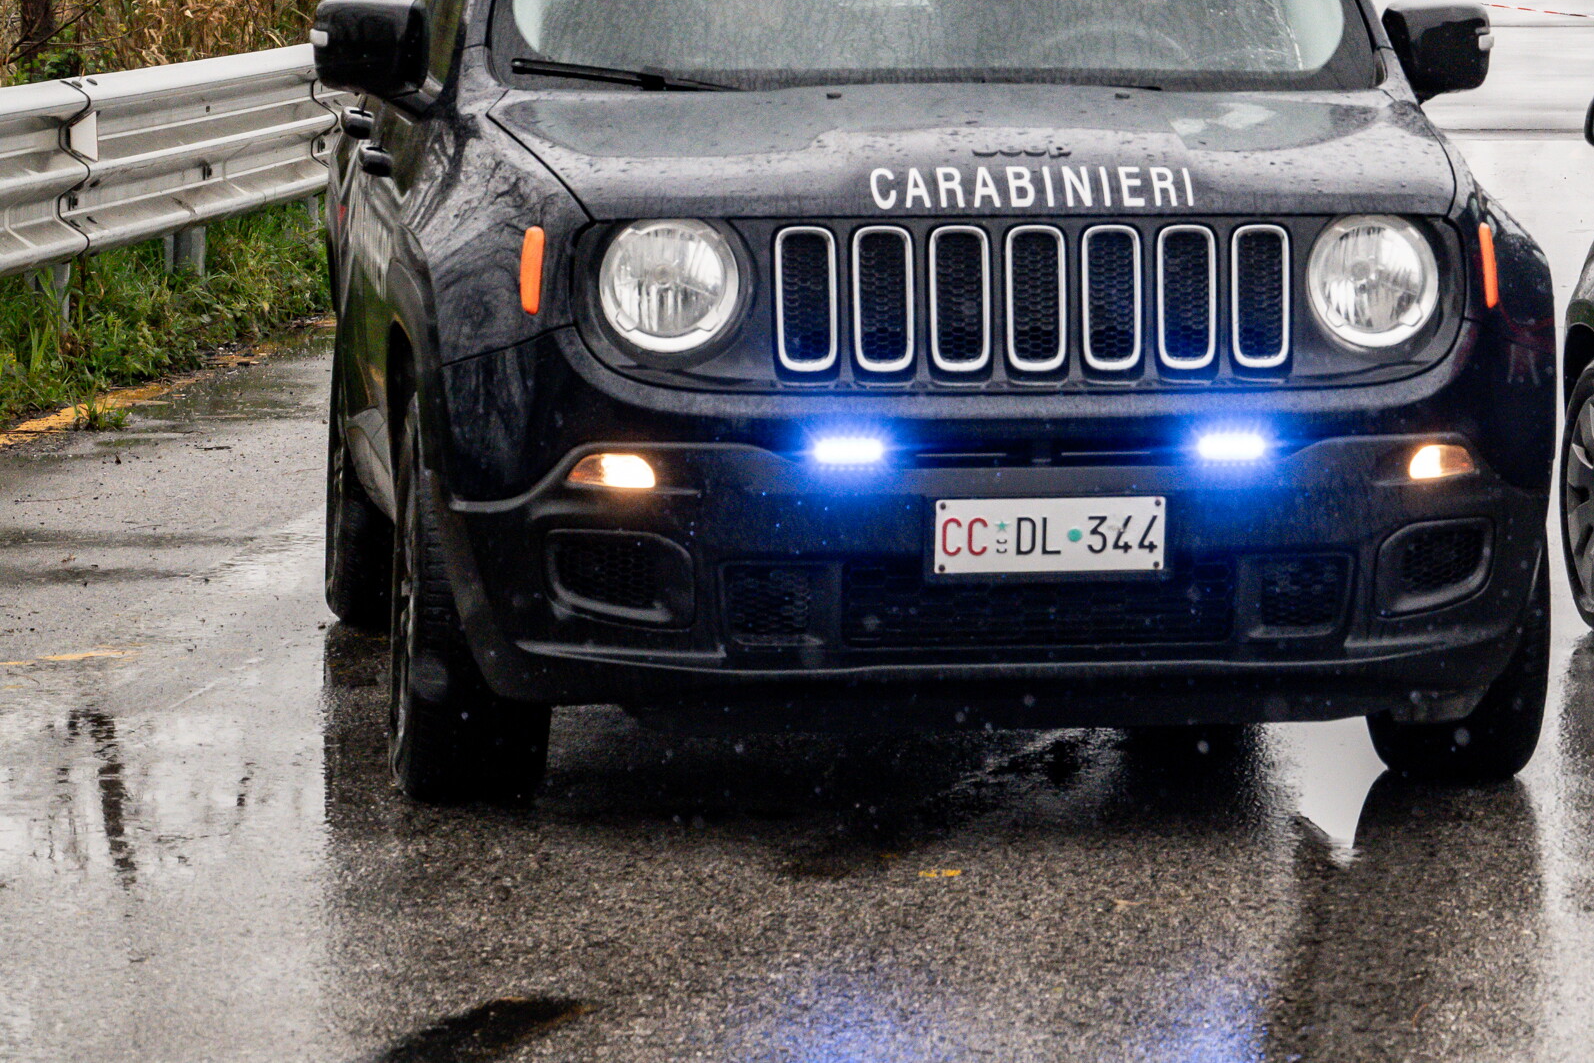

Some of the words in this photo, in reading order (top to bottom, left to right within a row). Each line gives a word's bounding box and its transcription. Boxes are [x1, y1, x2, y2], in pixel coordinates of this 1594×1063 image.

[869, 165, 1194, 210] CARABINIERI
[941, 517, 988, 557] CC
[1015, 516, 1062, 556] DL
[1086, 514, 1159, 554] 344
